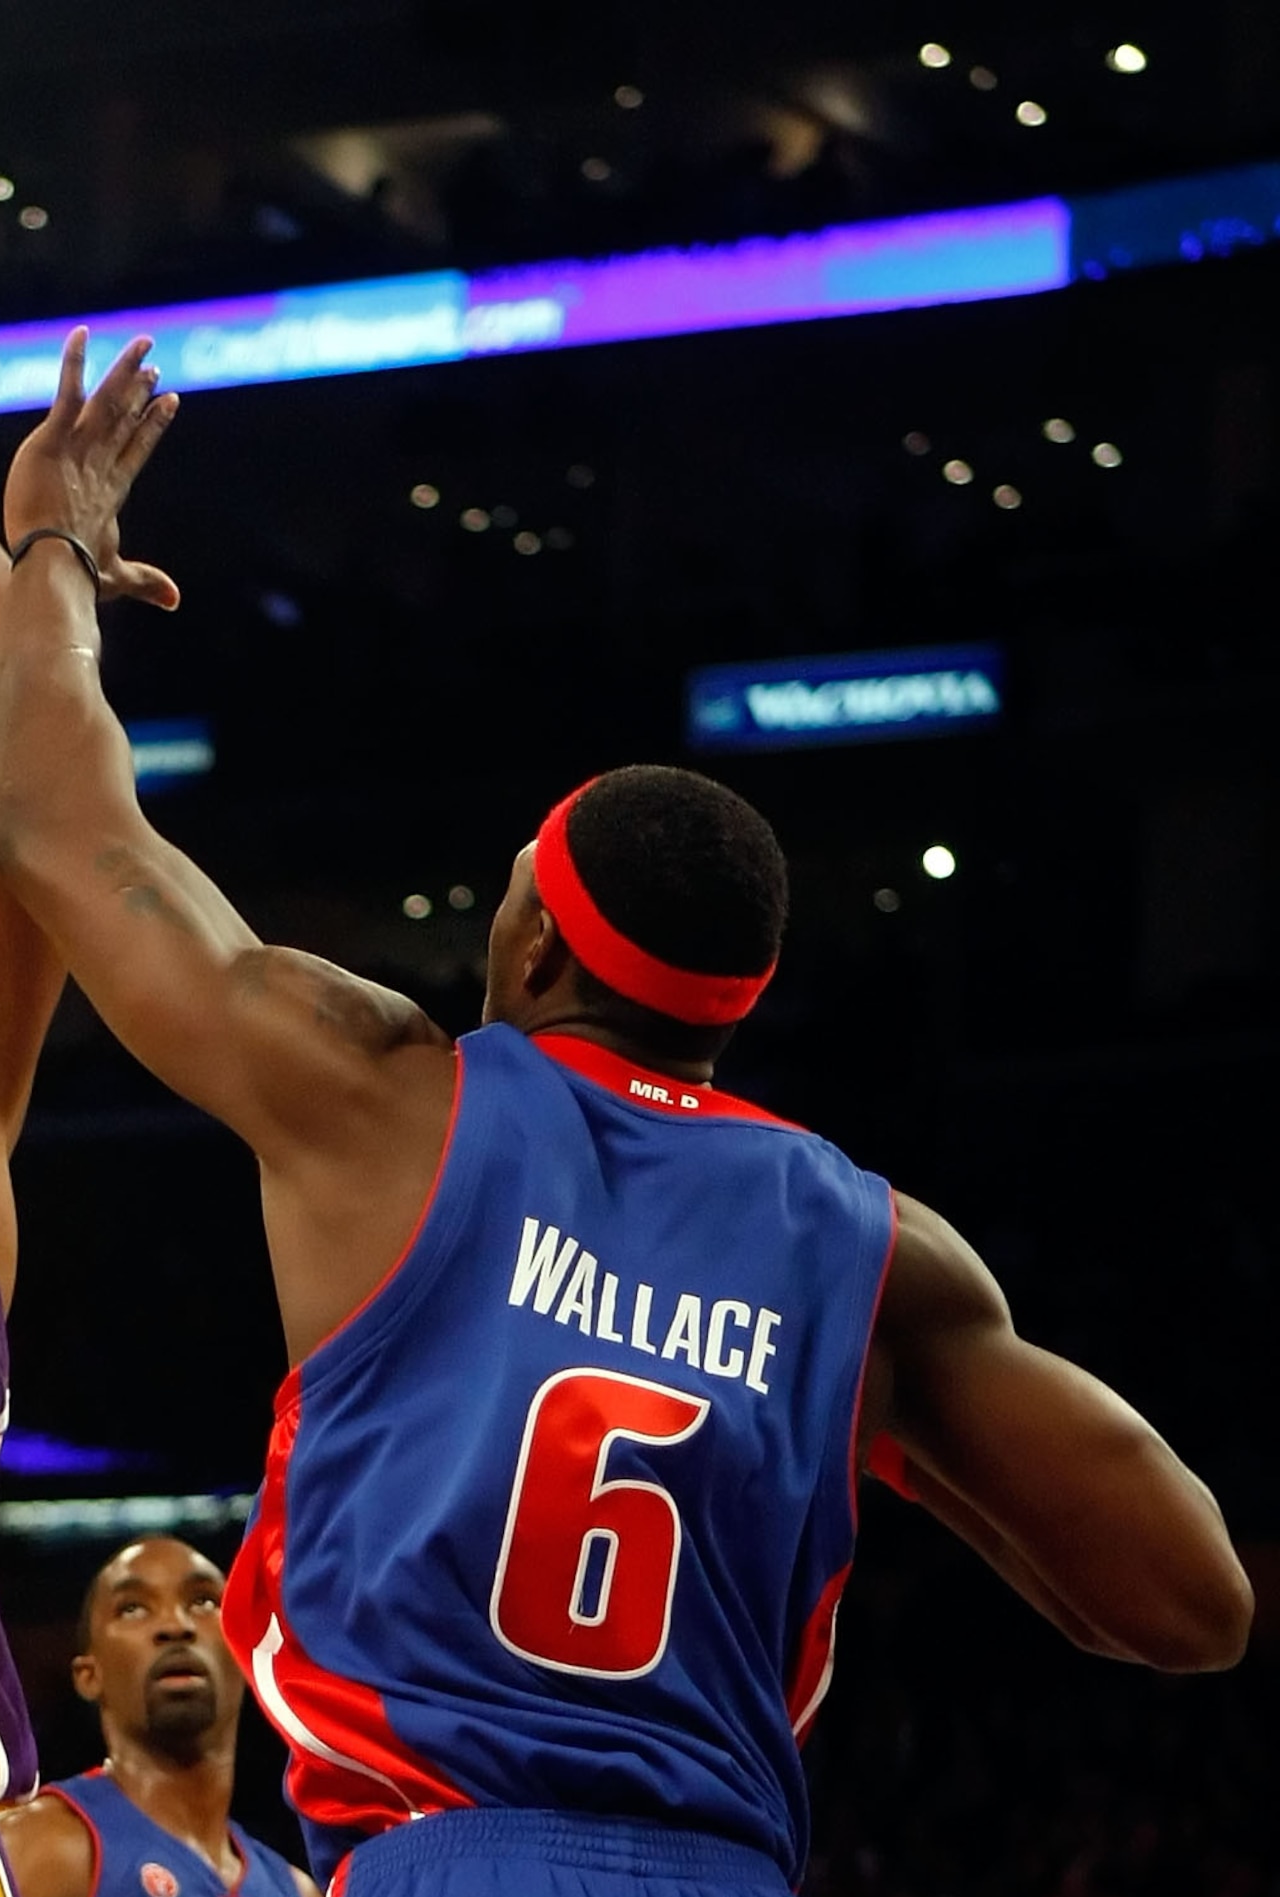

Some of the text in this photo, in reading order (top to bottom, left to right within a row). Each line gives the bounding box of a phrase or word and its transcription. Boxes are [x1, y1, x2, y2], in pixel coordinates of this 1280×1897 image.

[629, 1079, 699, 1109] MR. D
[508, 1216, 782, 1395] WALLACE
[489, 1366, 711, 1680] 6
